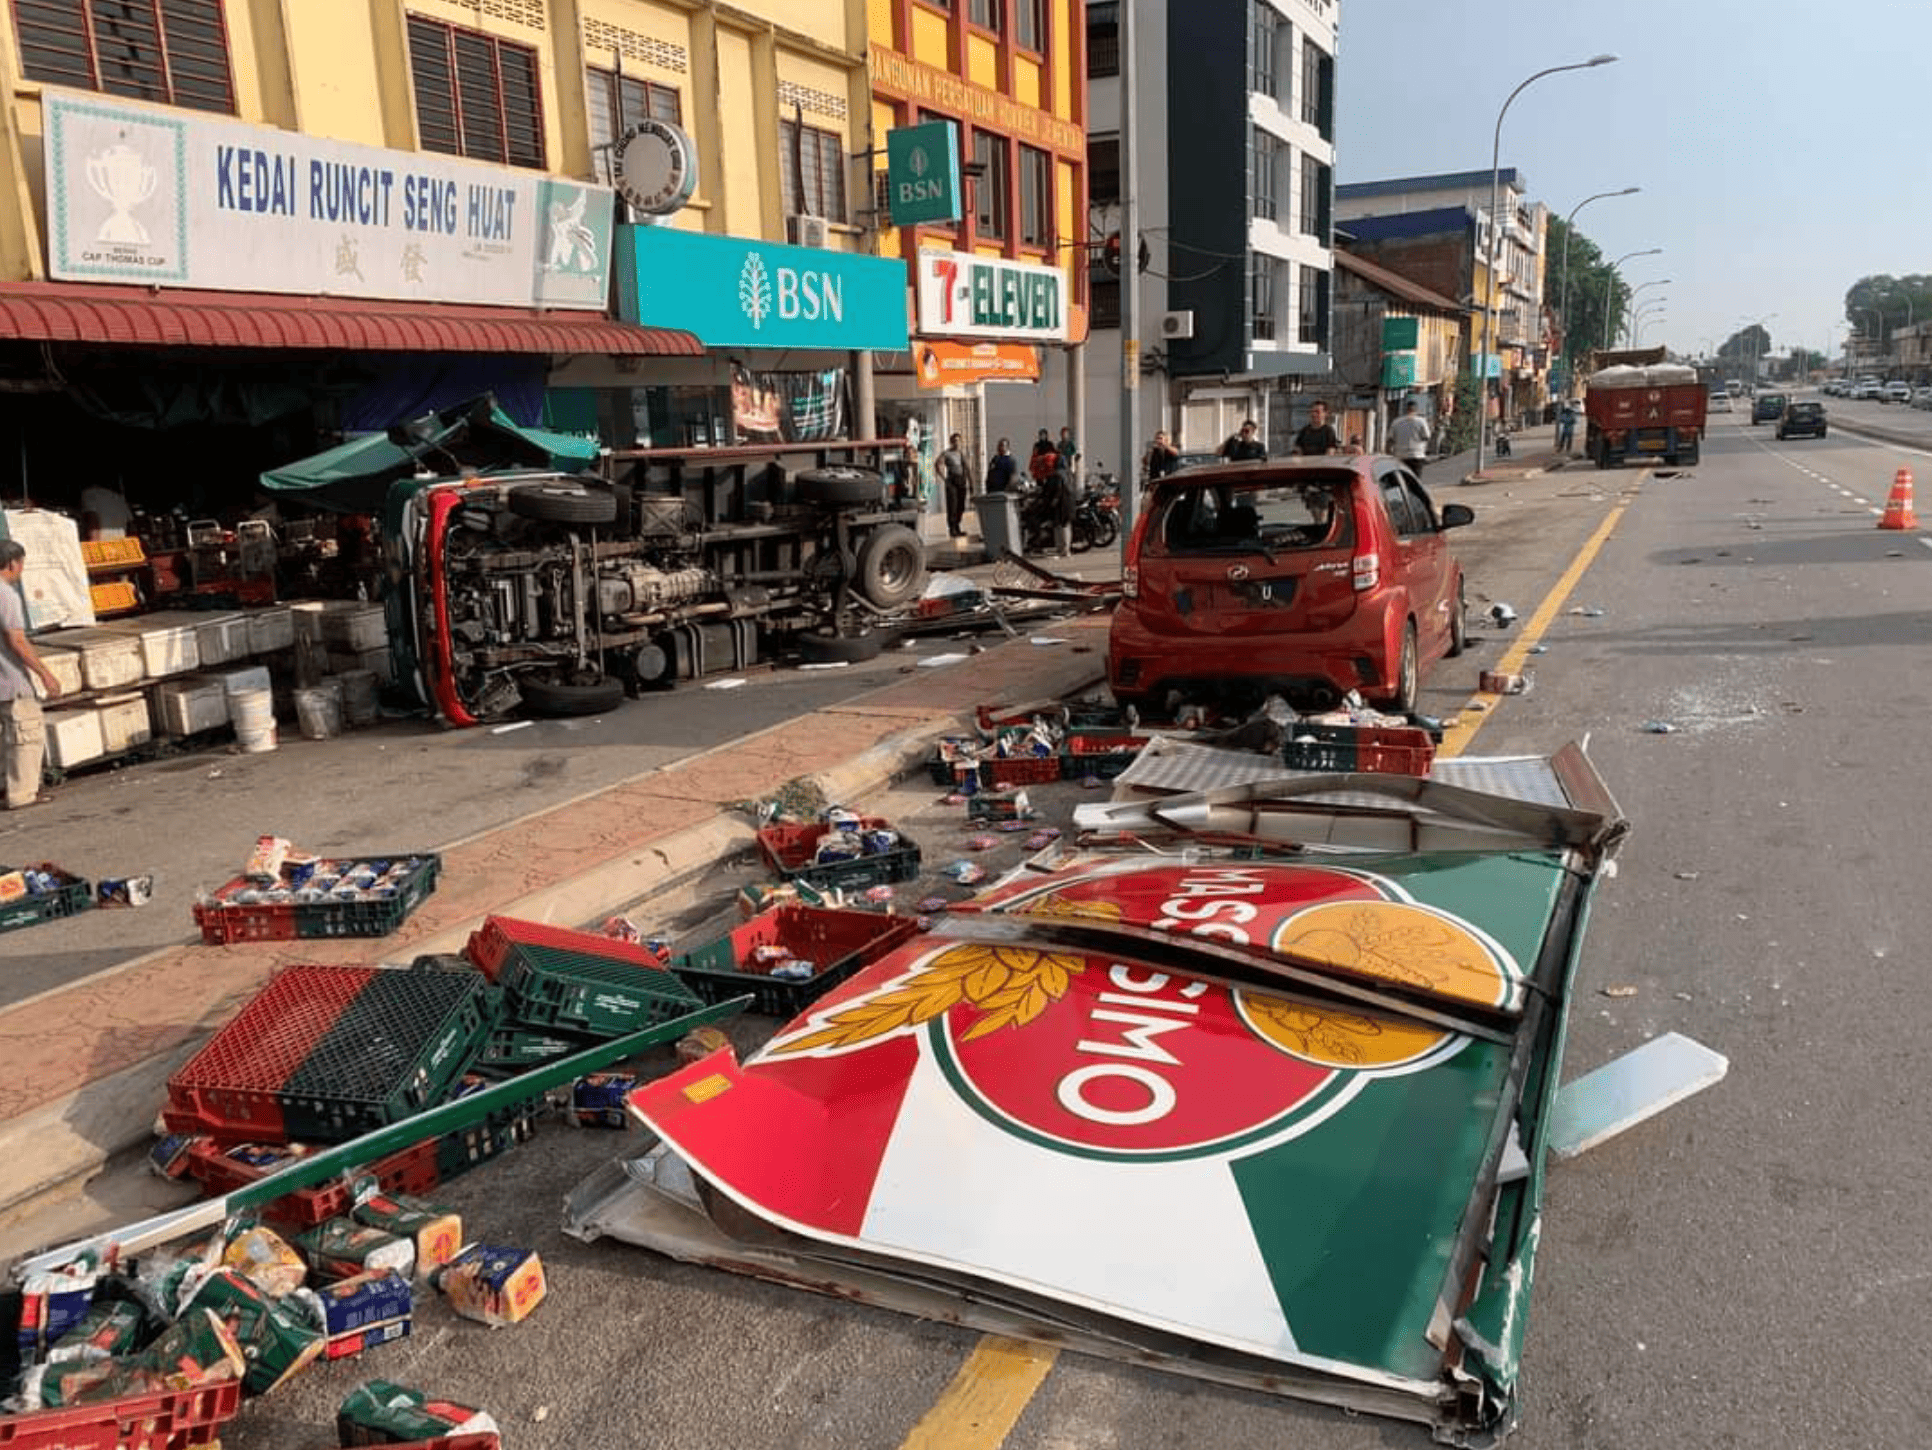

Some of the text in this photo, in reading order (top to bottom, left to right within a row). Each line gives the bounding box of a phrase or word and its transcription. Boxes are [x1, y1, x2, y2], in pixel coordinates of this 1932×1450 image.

[217, 144, 517, 241] KEDAI RUNCIT SENG HUAT
[898, 178, 943, 203] BSN
[776, 266, 843, 323] BSN
